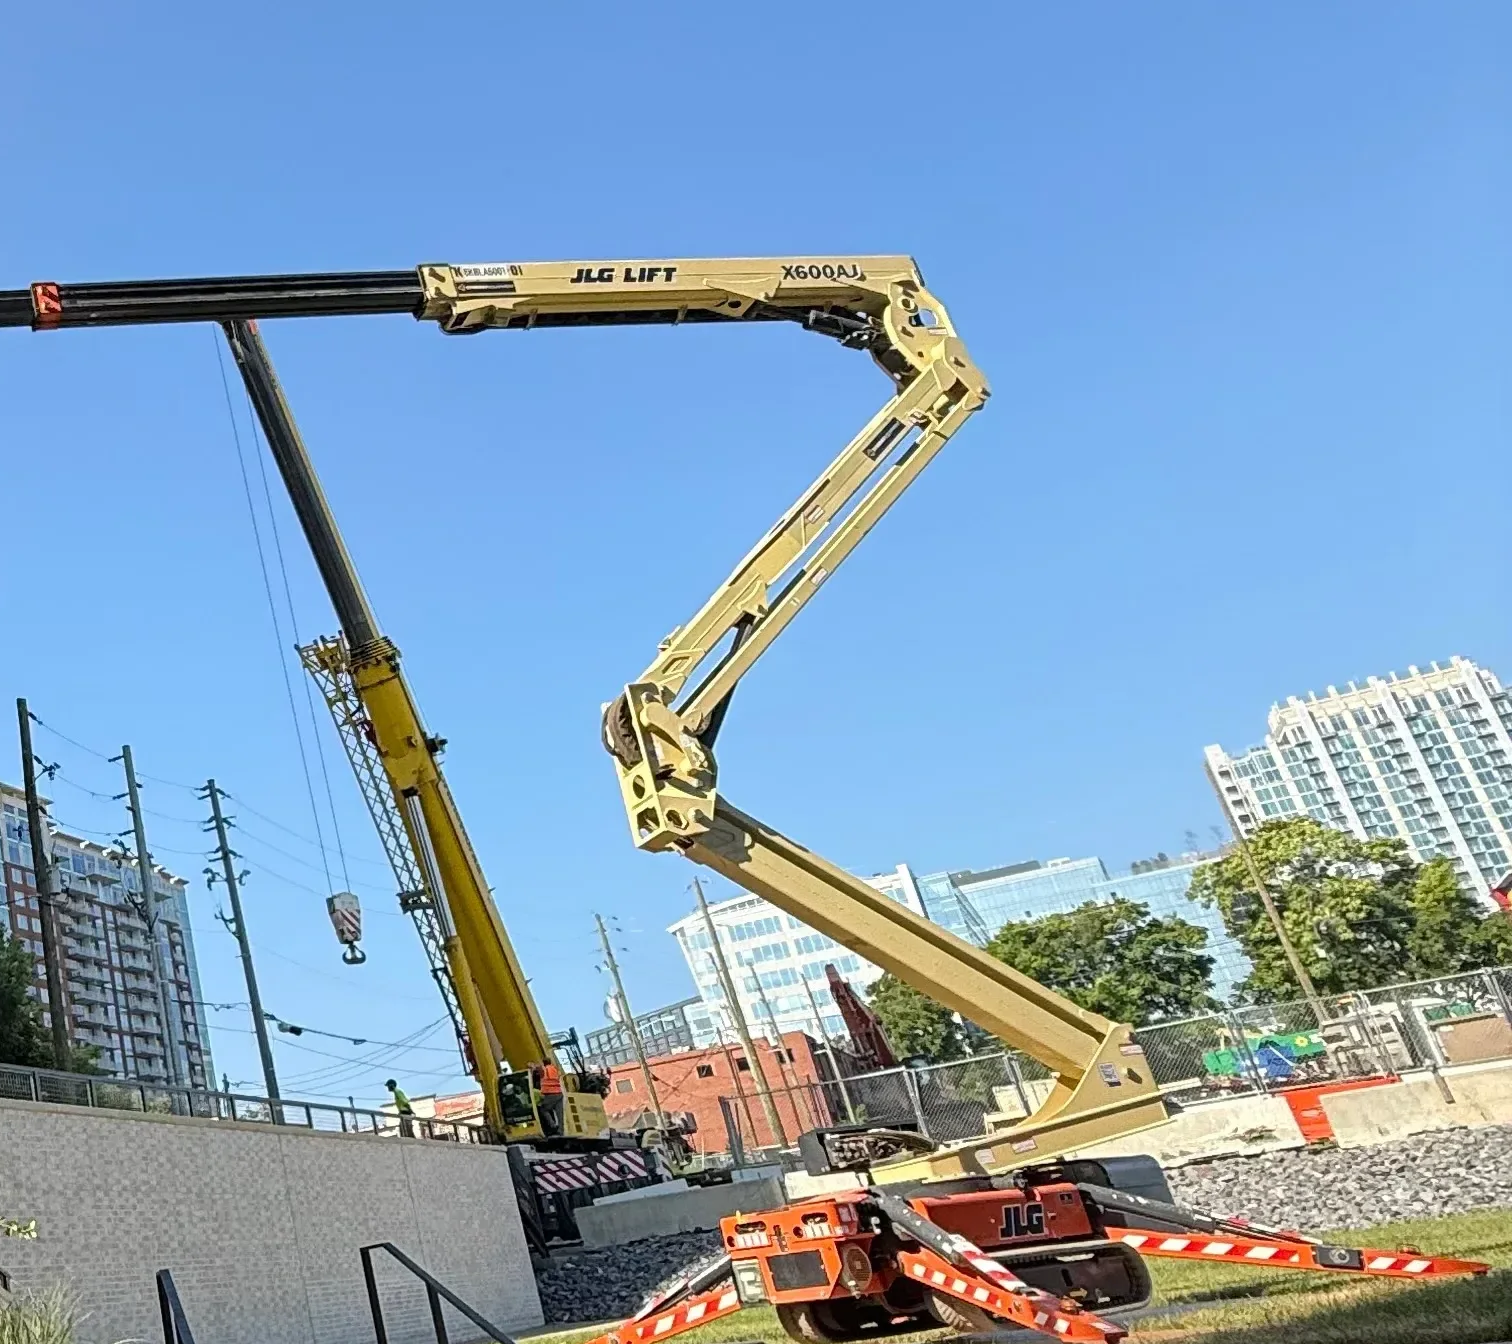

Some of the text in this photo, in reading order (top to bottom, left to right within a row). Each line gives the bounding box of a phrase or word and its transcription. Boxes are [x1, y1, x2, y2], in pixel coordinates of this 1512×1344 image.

[570, 267, 677, 284] JLG LIFT
[781, 264, 859, 281] X600AJ
[998, 1202, 1045, 1240] JLG
